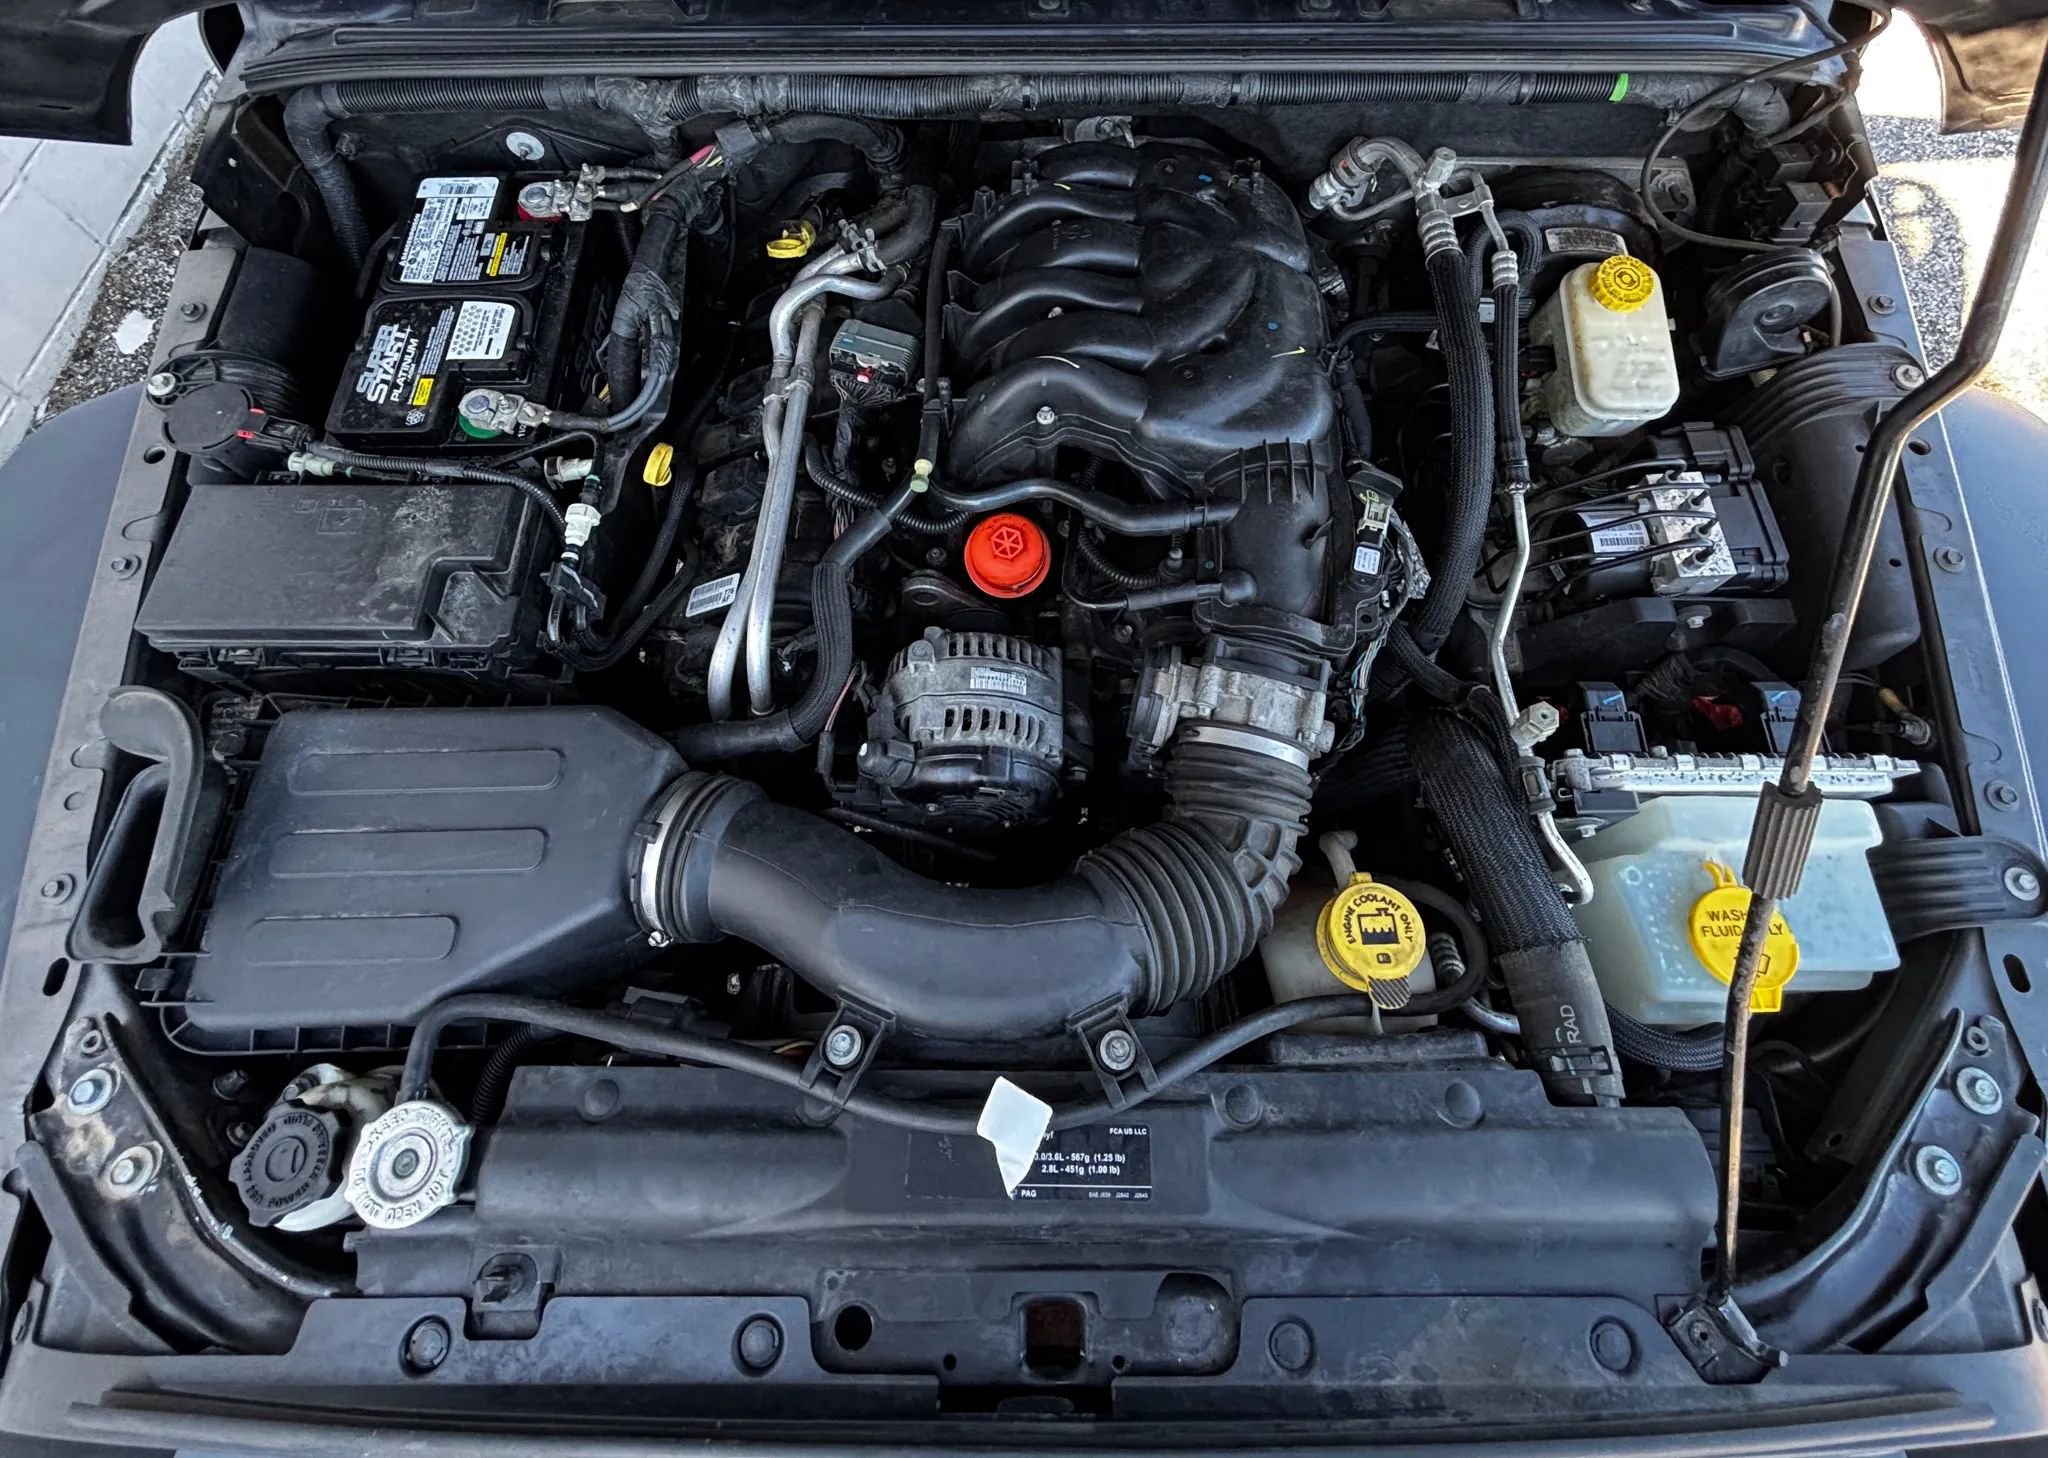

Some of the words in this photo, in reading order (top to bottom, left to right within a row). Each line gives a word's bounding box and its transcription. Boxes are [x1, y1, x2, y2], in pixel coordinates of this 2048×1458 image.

[356, 325, 396, 394] SUPER
[367, 324, 407, 404] START
[390, 338, 419, 402] PLATINUM
[1343, 905, 1356, 944] ENGINE
[1353, 893, 1402, 911] COOLANT
[1400, 913, 1414, 943] ONLY
[1707, 909, 1747, 922] WASH
[1702, 925, 1742, 937] FLUID
[1560, 1004, 1582, 1044] RAD
[367, 1107, 409, 1142] KEEP
[1109, 1127, 1123, 1135] FCA
[1041, 1164, 1059, 1173] 2.8L
[1065, 1165, 1085, 1175] 451g
[1089, 1165, 1108, 1175] (1.00
[1109, 1165, 1121, 1176] lb)
[1071, 1153, 1090, 1163] 567g
[1094, 1153, 1113, 1163] (1.25
[1115, 1153, 1126, 1164] lb)
[352, 1167, 367, 1187] DO
[424, 1168, 450, 1202] HOT
[356, 1190, 385, 1217] NOT
[1021, 1189, 1037, 1198] PAG
[385, 1199, 422, 1222] OPEN
